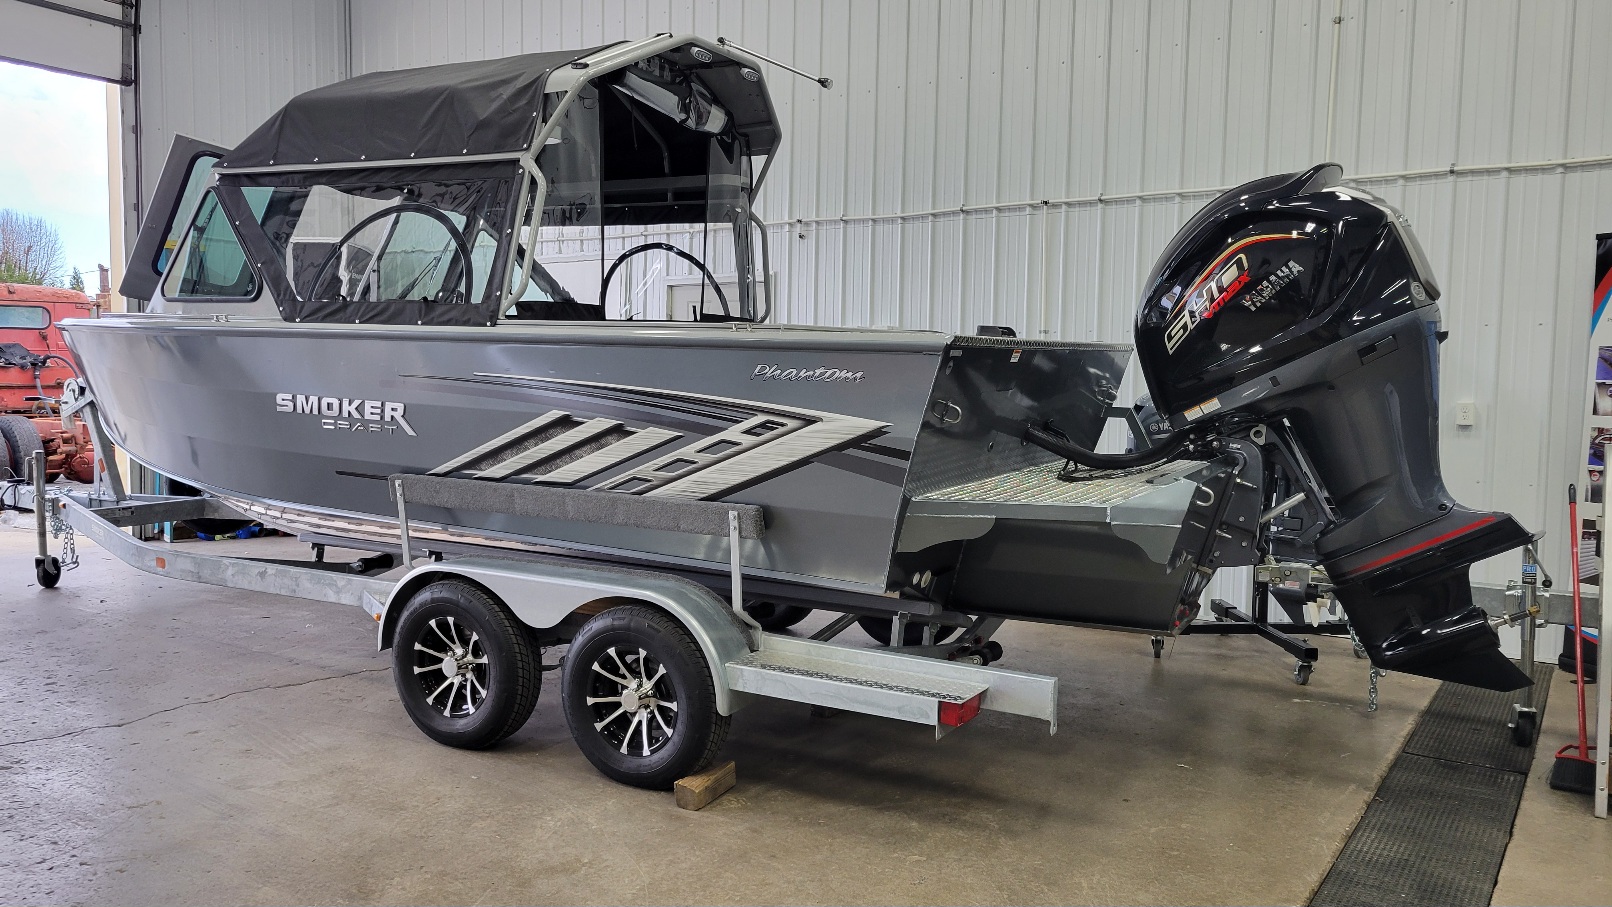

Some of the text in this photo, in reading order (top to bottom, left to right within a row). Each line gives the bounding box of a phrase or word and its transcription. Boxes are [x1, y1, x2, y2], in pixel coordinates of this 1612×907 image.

[1164, 253, 1249, 356] SHO
[1240, 259, 1305, 312] YAMAHA
[750, 364, 865, 382] Phantom
[276, 393, 418, 436] SMOKER
[321, 419, 398, 435] CRAFT
